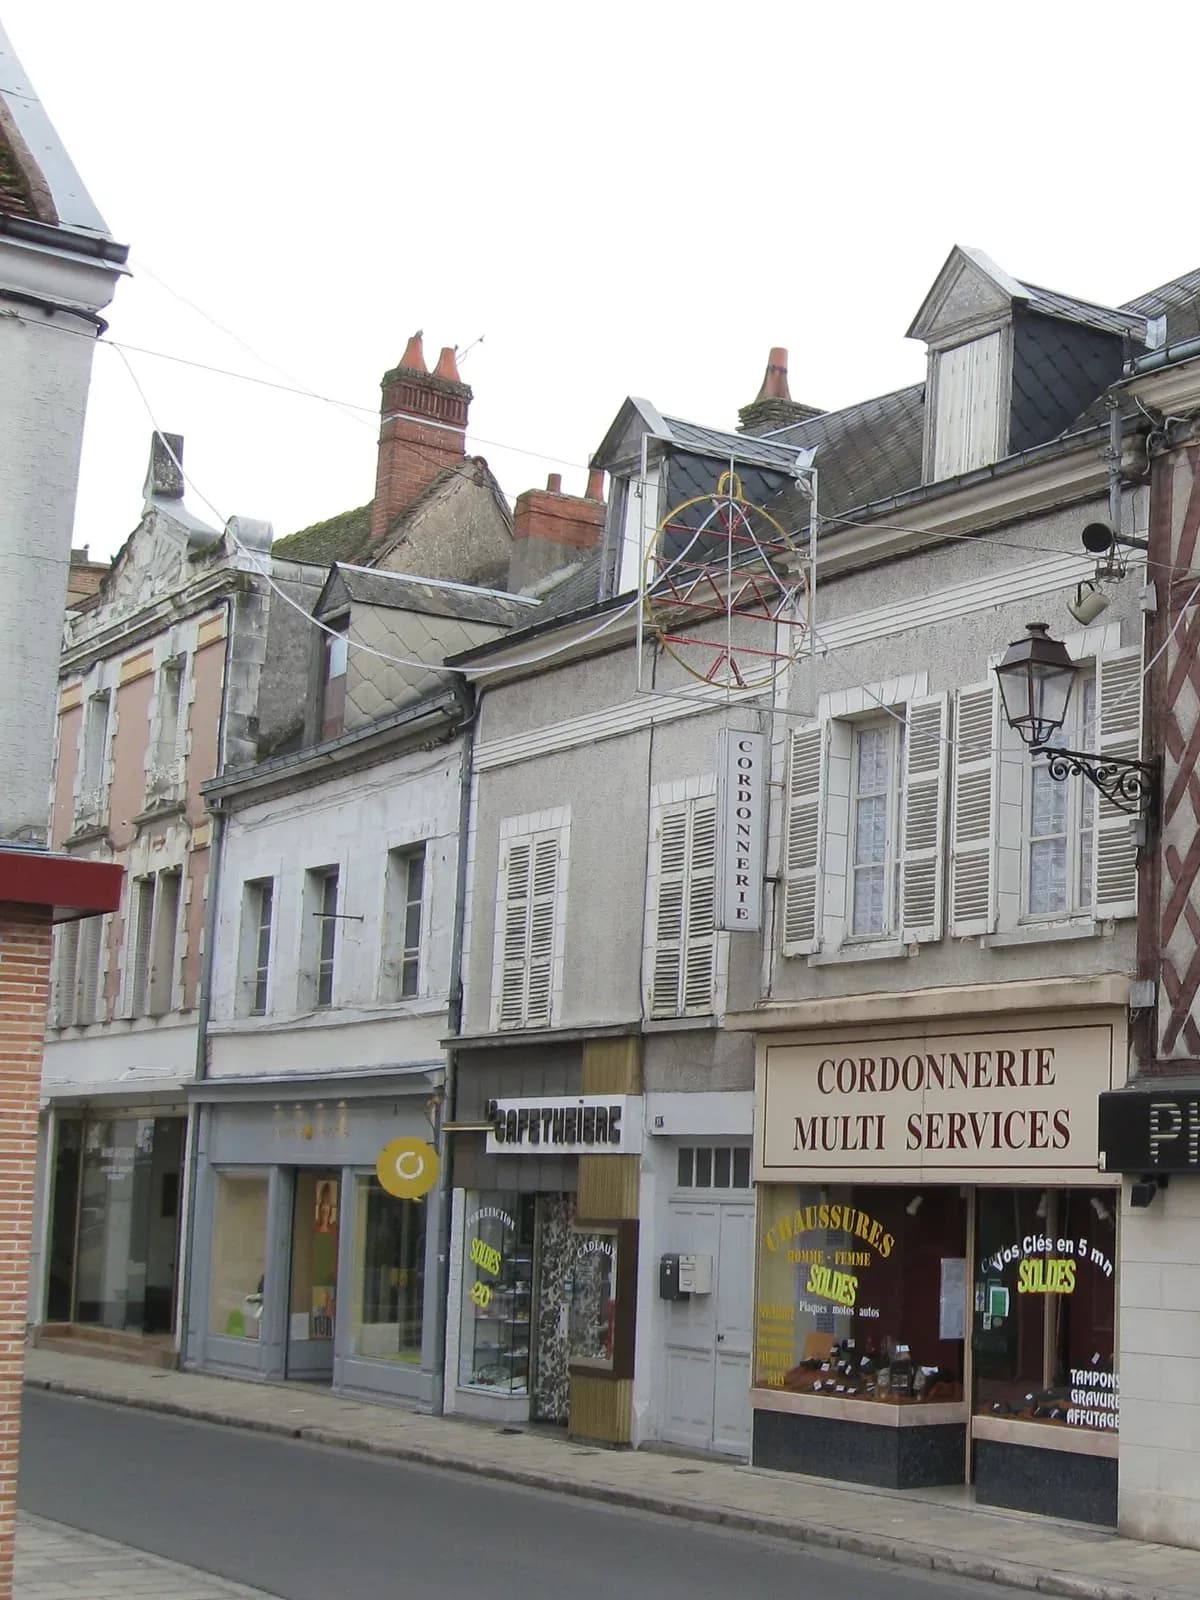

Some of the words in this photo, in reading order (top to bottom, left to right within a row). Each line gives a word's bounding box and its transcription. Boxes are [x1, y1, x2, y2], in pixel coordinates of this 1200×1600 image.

[736, 740, 753, 921] CORDONNERIE
[817, 1047, 1057, 1095] CORDONNERIE
[793, 1114, 886, 1151] MULTI
[906, 1109, 1071, 1151] SERVICES
[766, 1204, 895, 1258] CHAUSSURES
[470, 1238, 502, 1276] SOLDES
[835, 1251, 871, 1267] FEMME
[993, 1243, 1020, 1271] Vos
[1023, 1233, 1053, 1254] Clés
[1057, 1238, 1074, 1253] en
[1078, 1238, 1088, 1256] 5
[1091, 1247, 1113, 1277] mn
[1017, 1258, 1076, 1294] SOLDES
[807, 1263, 858, 1307] SOLDES
[800, 1300, 827, 1315] Plaques
[832, 1304, 855, 1316] motos
[859, 1306, 880, 1318] autos
[1066, 1408, 1120, 1429] AFFUTAGE
